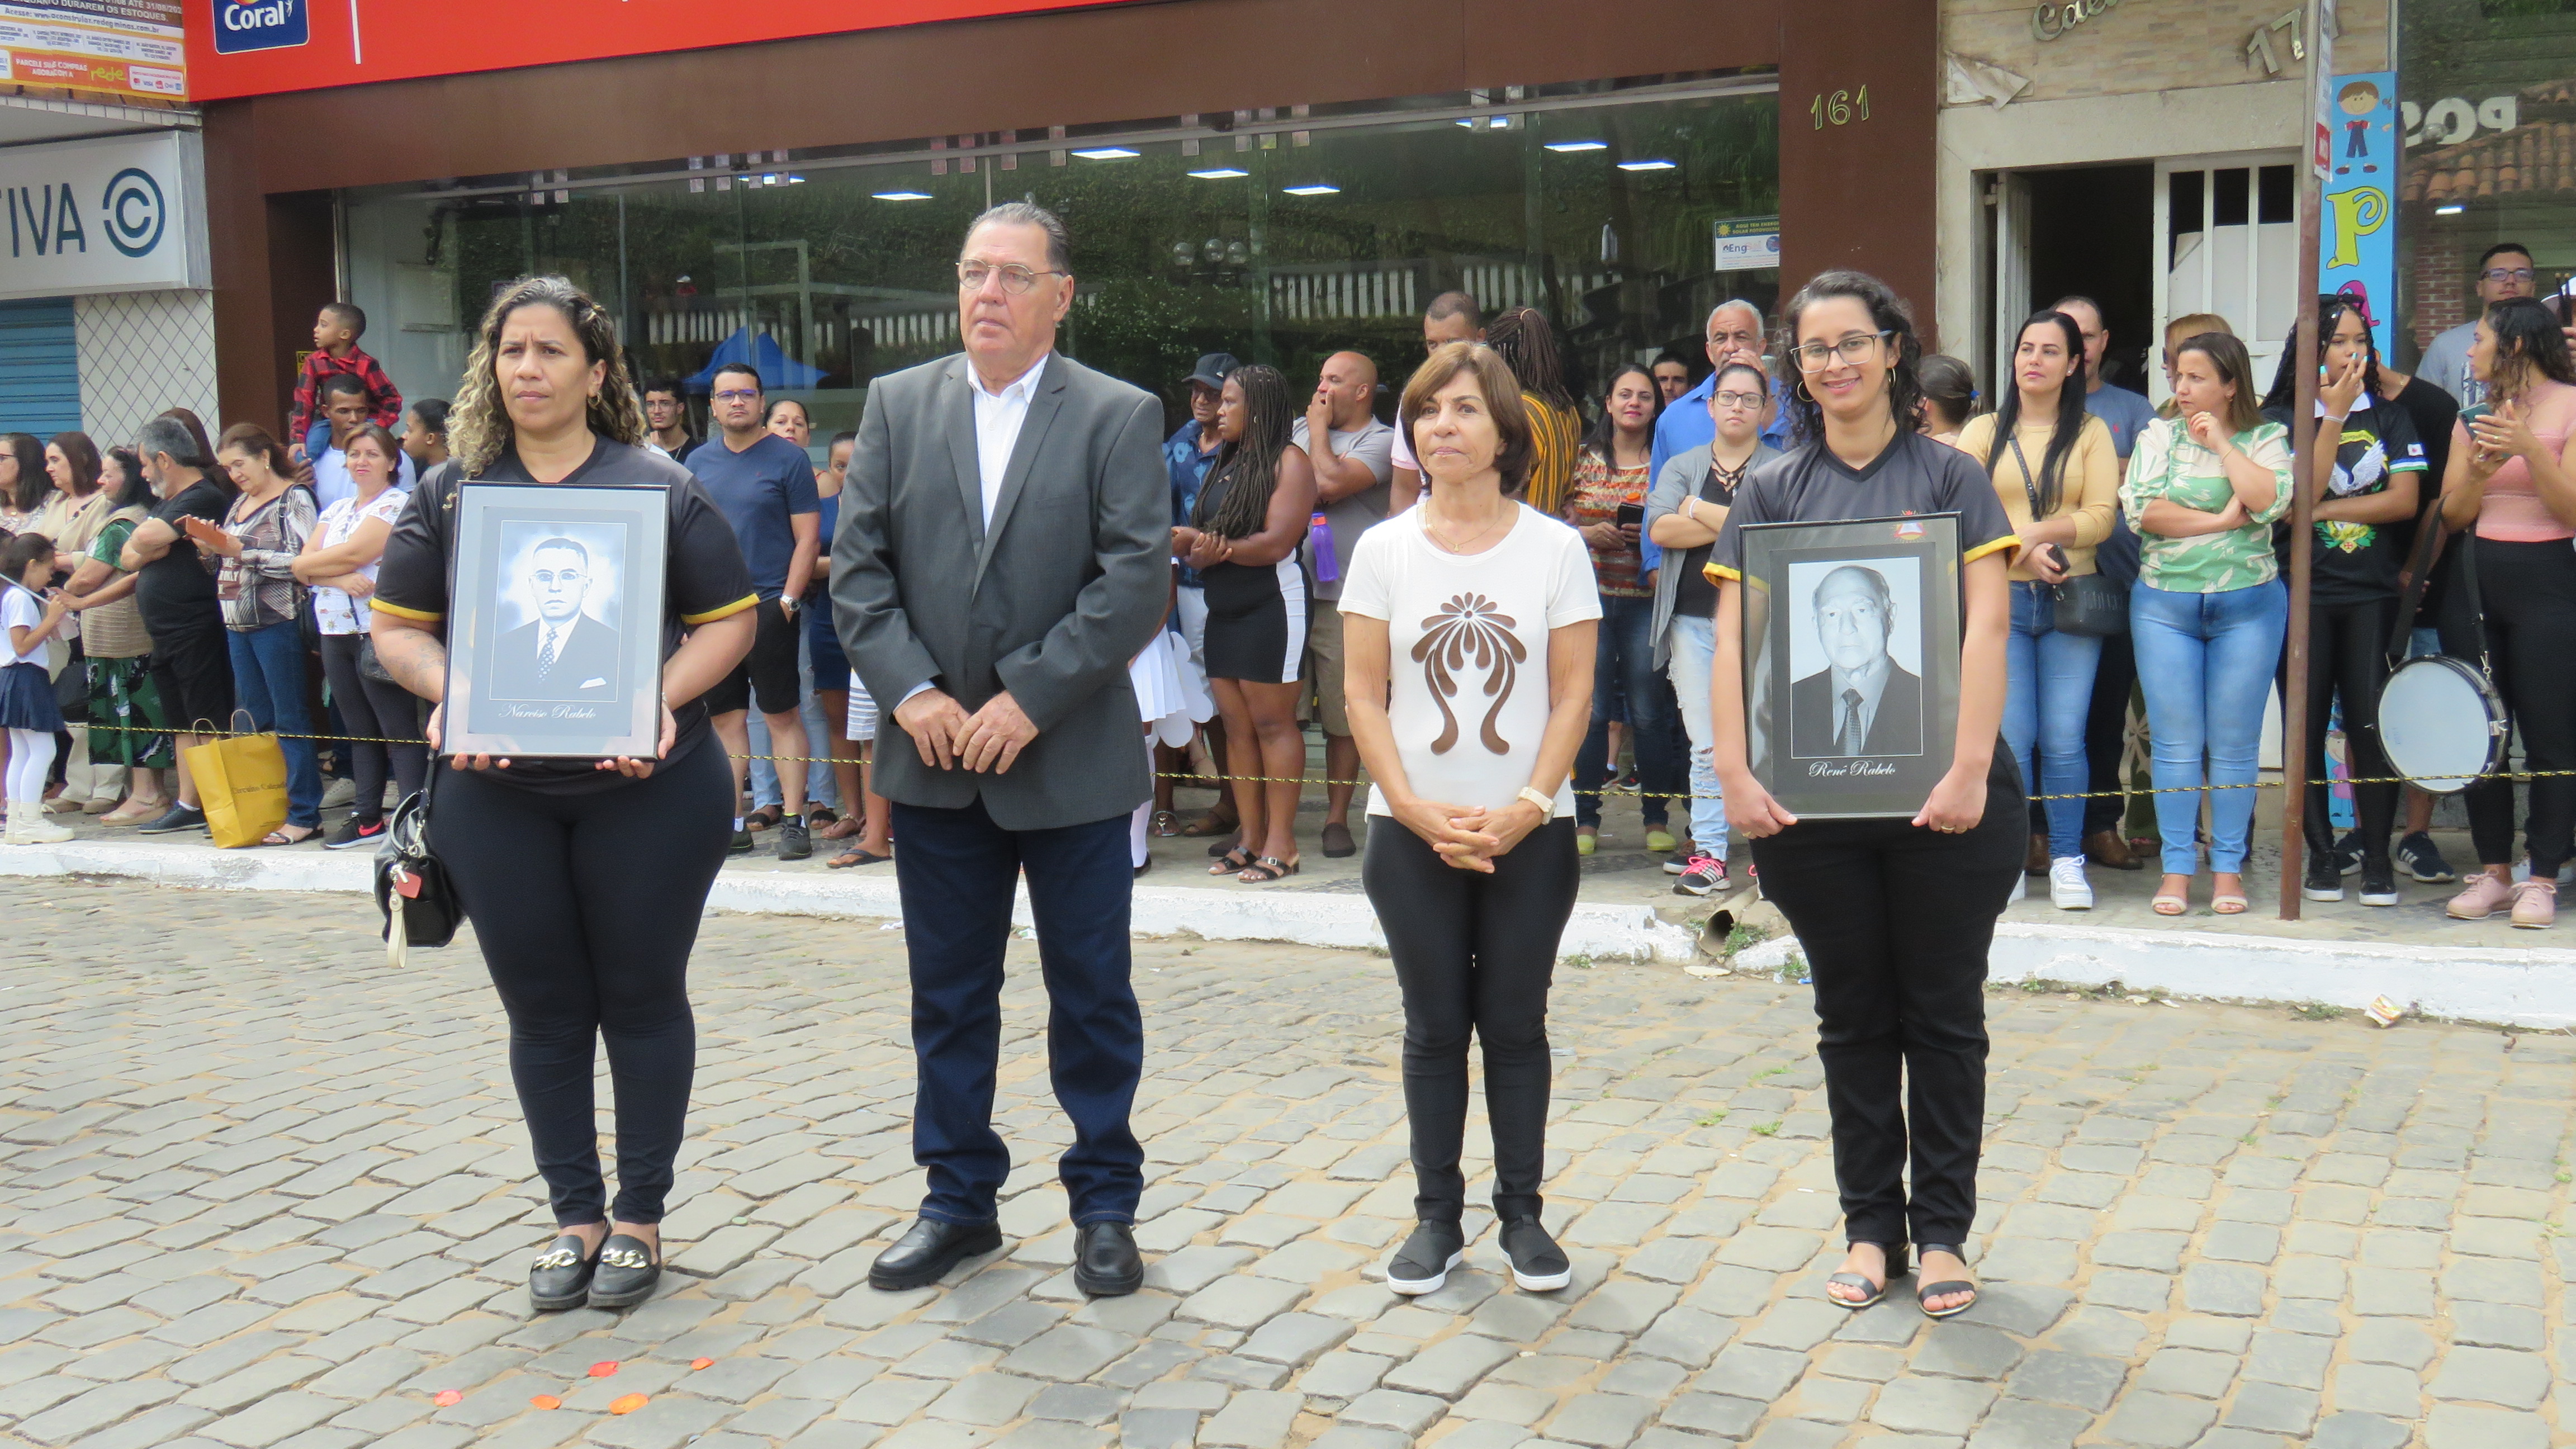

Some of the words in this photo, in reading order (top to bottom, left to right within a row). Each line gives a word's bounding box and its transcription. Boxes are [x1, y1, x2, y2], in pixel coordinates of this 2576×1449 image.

[5, 7, 32, 17] Acesse:
[106, 5, 119, 15] OS
[225, 0, 285, 31] Coral
[91, 67, 127, 82] rede
[1811, 84, 1869, 130] 161
[0, 182, 86, 258] IVA
[499, 703, 547, 719] Narciso
[551, 704, 596, 719] Rabelo
[1808, 761, 1846, 777] René
[1849, 760, 1896, 776] Rabelo
